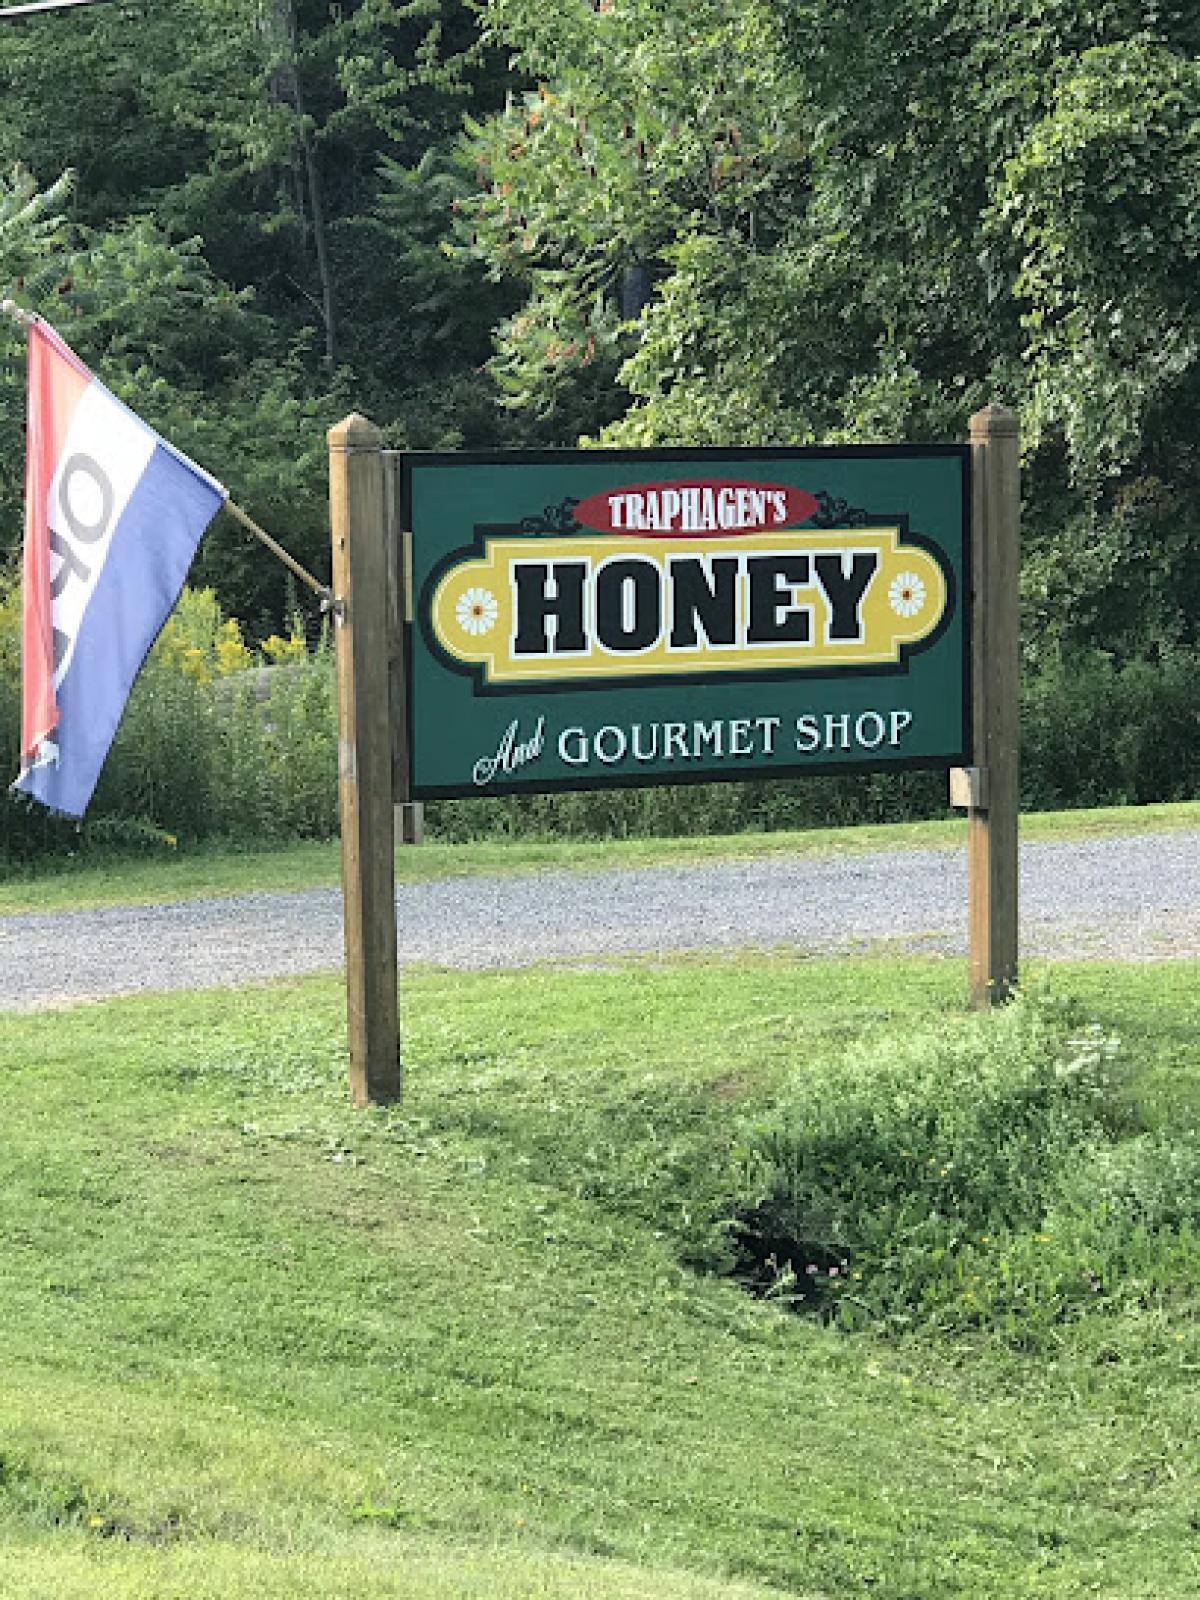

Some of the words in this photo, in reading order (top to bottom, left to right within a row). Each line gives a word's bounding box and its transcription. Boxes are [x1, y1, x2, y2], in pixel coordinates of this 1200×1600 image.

[608, 486, 787, 531] TRAPHAGEN'S
[511, 549, 879, 658] HONEY
[473, 716, 545, 785] And
[558, 716, 780, 765] GOURMET
[795, 709, 912, 752] SHOP
